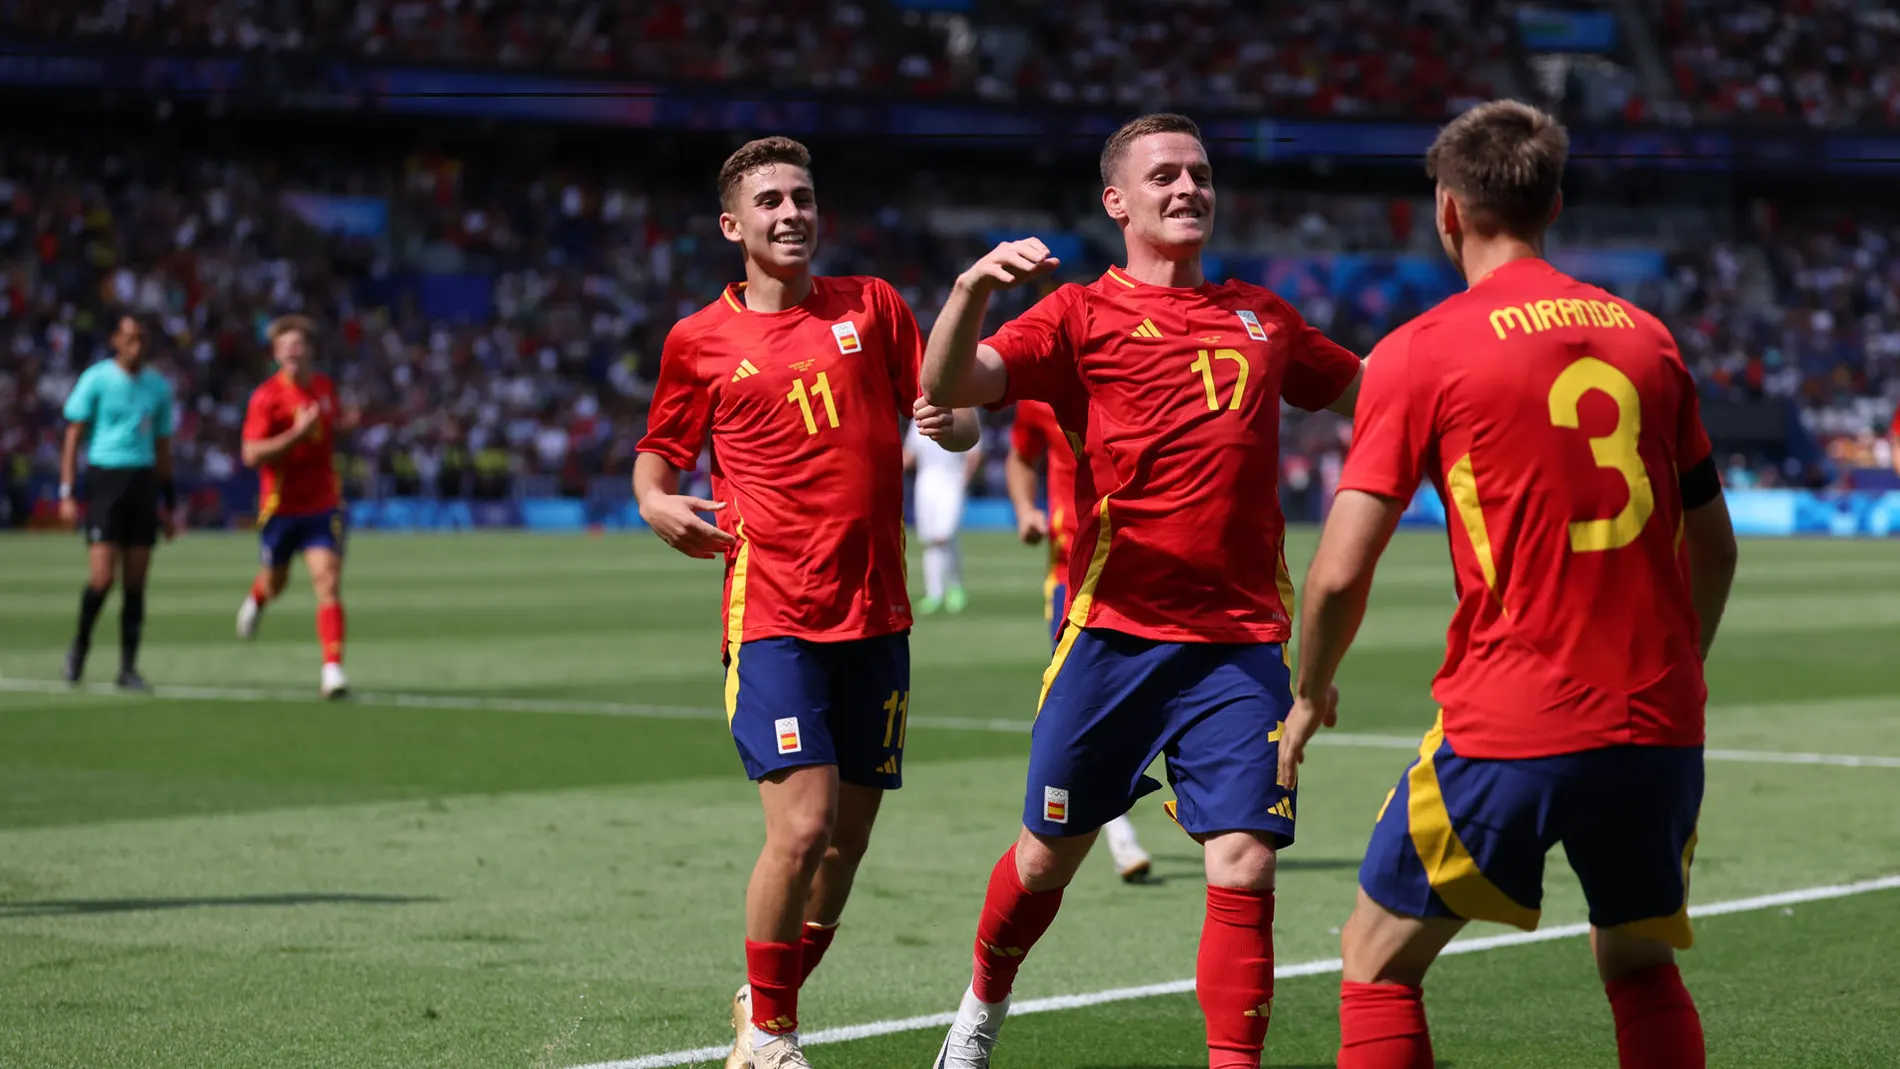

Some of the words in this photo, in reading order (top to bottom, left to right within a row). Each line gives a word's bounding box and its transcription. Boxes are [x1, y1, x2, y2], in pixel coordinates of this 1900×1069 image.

[1489, 298, 1635, 339] MIRANDA
[786, 371, 840, 435] 11
[1191, 349, 1249, 410] 17
[1548, 357, 1654, 553] 3
[883, 690, 909, 748] 11
